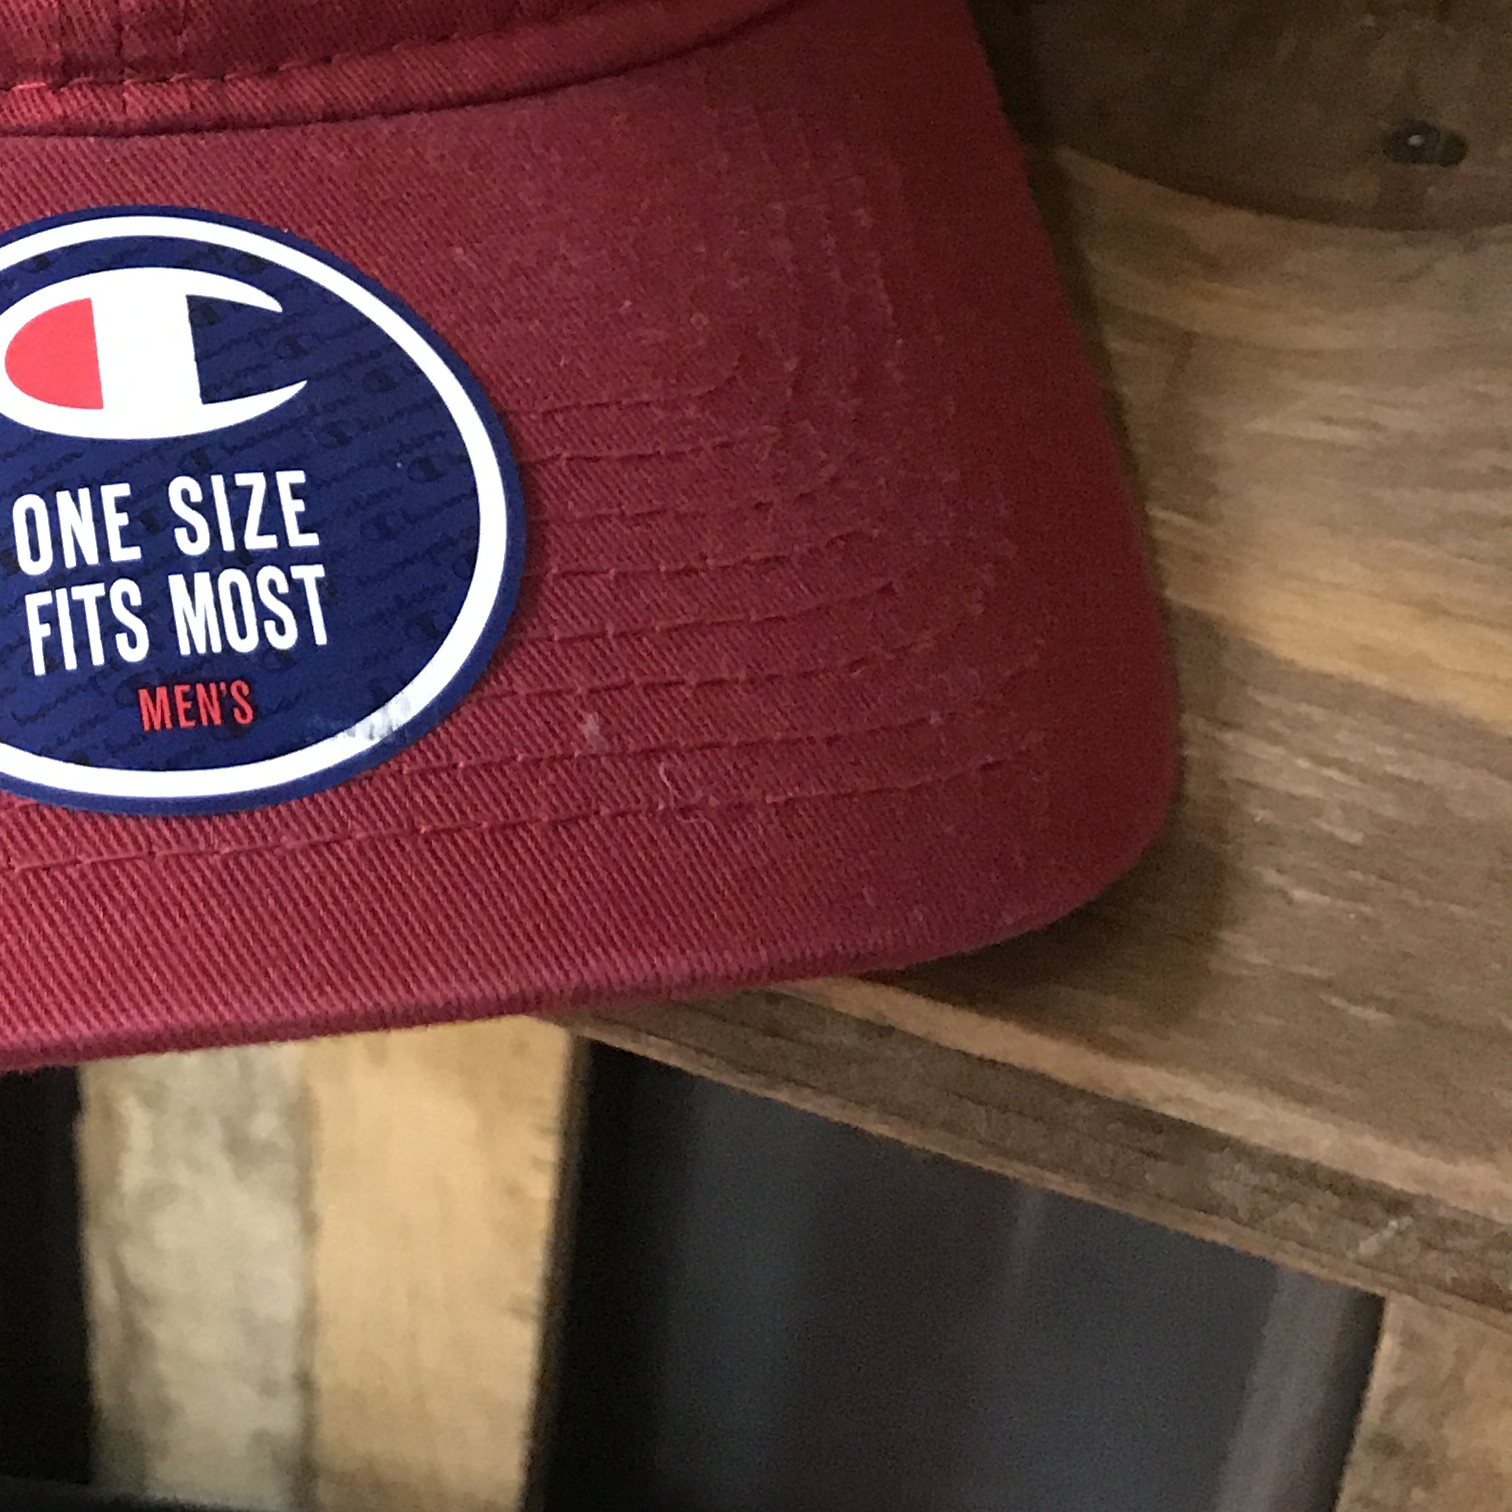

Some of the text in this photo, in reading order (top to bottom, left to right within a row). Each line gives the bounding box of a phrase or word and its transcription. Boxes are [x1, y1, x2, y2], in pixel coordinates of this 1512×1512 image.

[11, 469, 320, 577] ONE SIZE
[24, 564, 328, 677] FITS MOST
[138, 678, 256, 733] MEN'S
